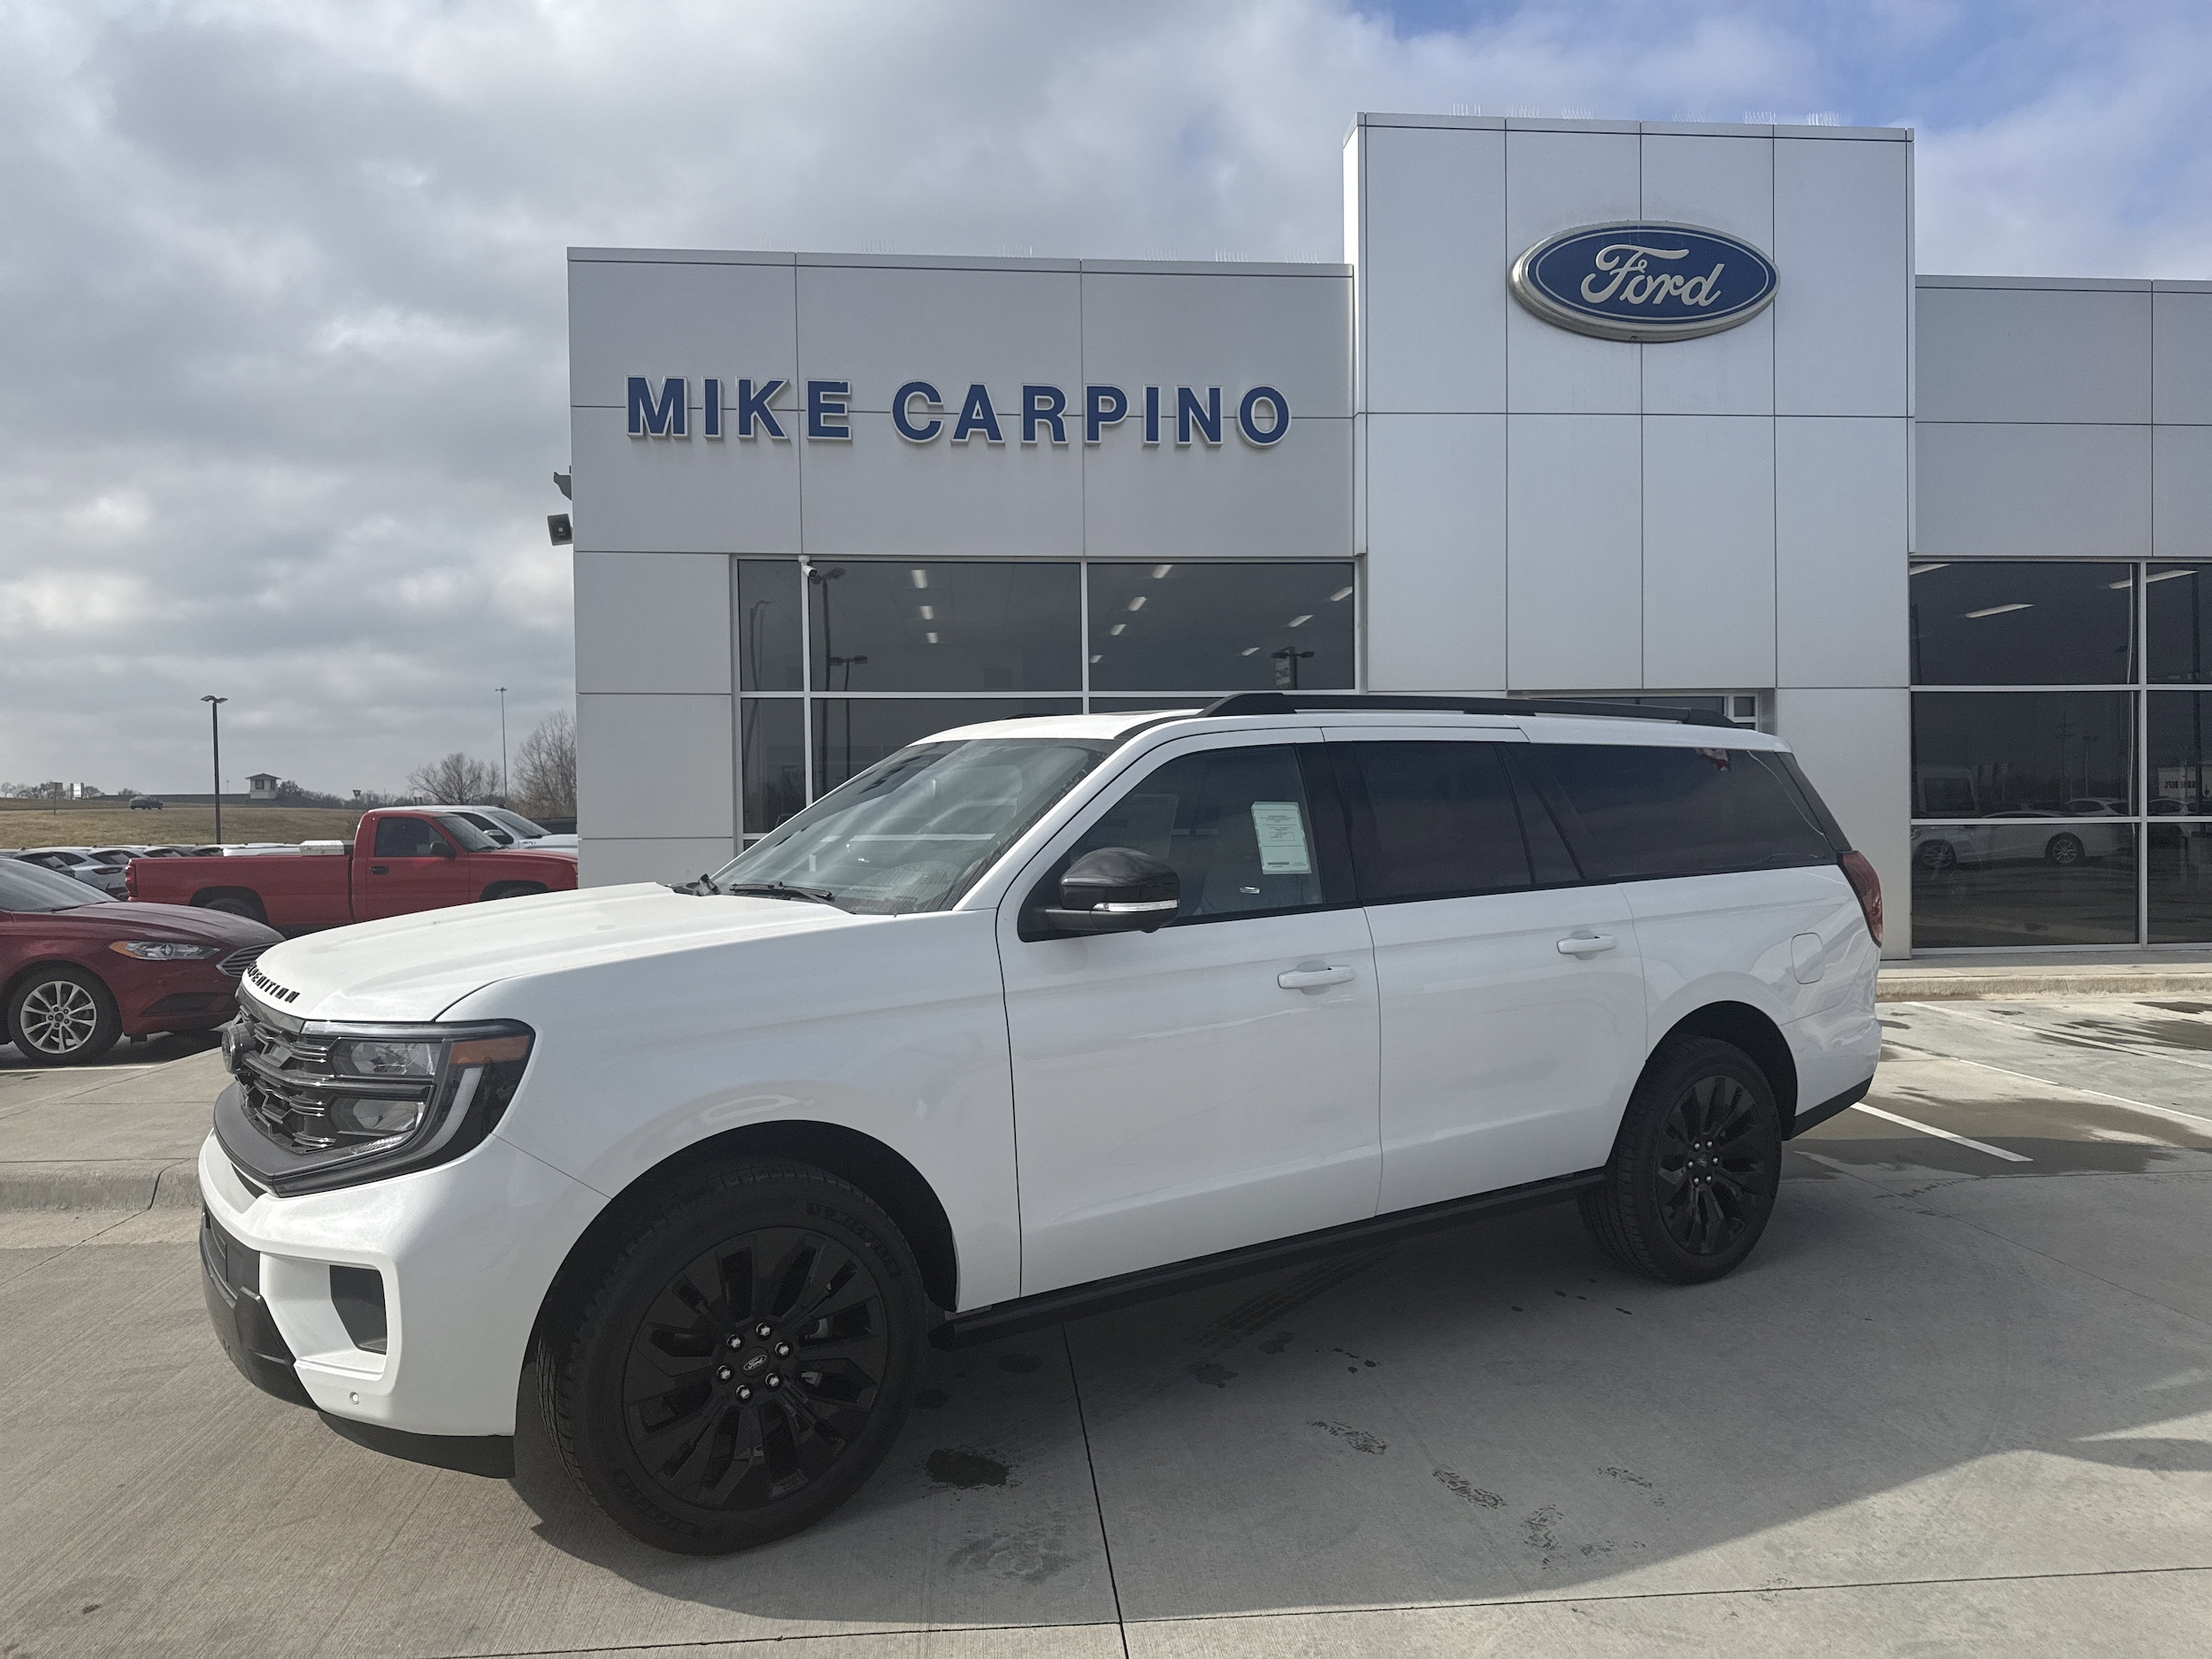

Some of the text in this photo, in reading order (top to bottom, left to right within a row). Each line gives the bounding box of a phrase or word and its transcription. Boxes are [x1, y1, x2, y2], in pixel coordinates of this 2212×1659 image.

[1580, 243, 1724, 307] Ford
[625, 375, 1292, 448] MIKE CARPINO
